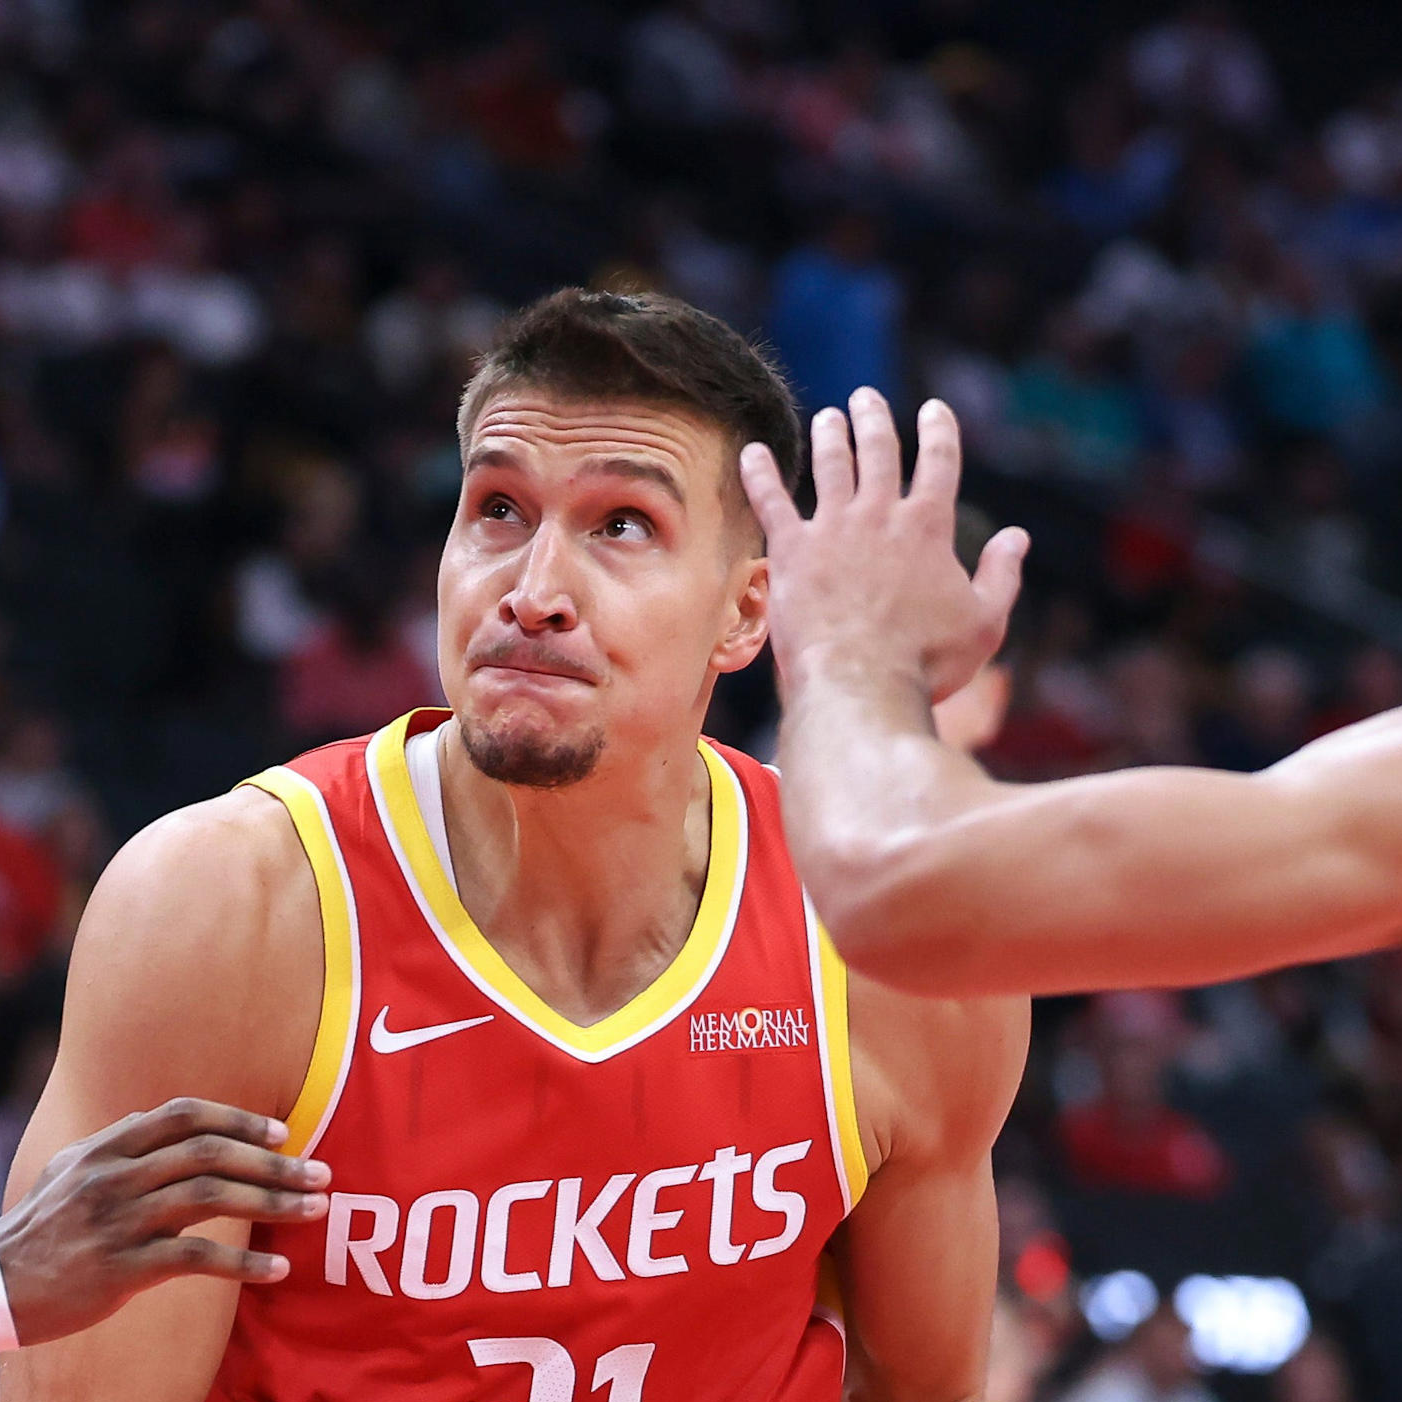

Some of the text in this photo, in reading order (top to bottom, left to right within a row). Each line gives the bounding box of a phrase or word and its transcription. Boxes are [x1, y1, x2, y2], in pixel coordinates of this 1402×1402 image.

[690, 1007, 809, 1034] MEMORIAL
[690, 1025, 808, 1052] HERMANN
[324, 1139, 813, 1301] ROCKETS
